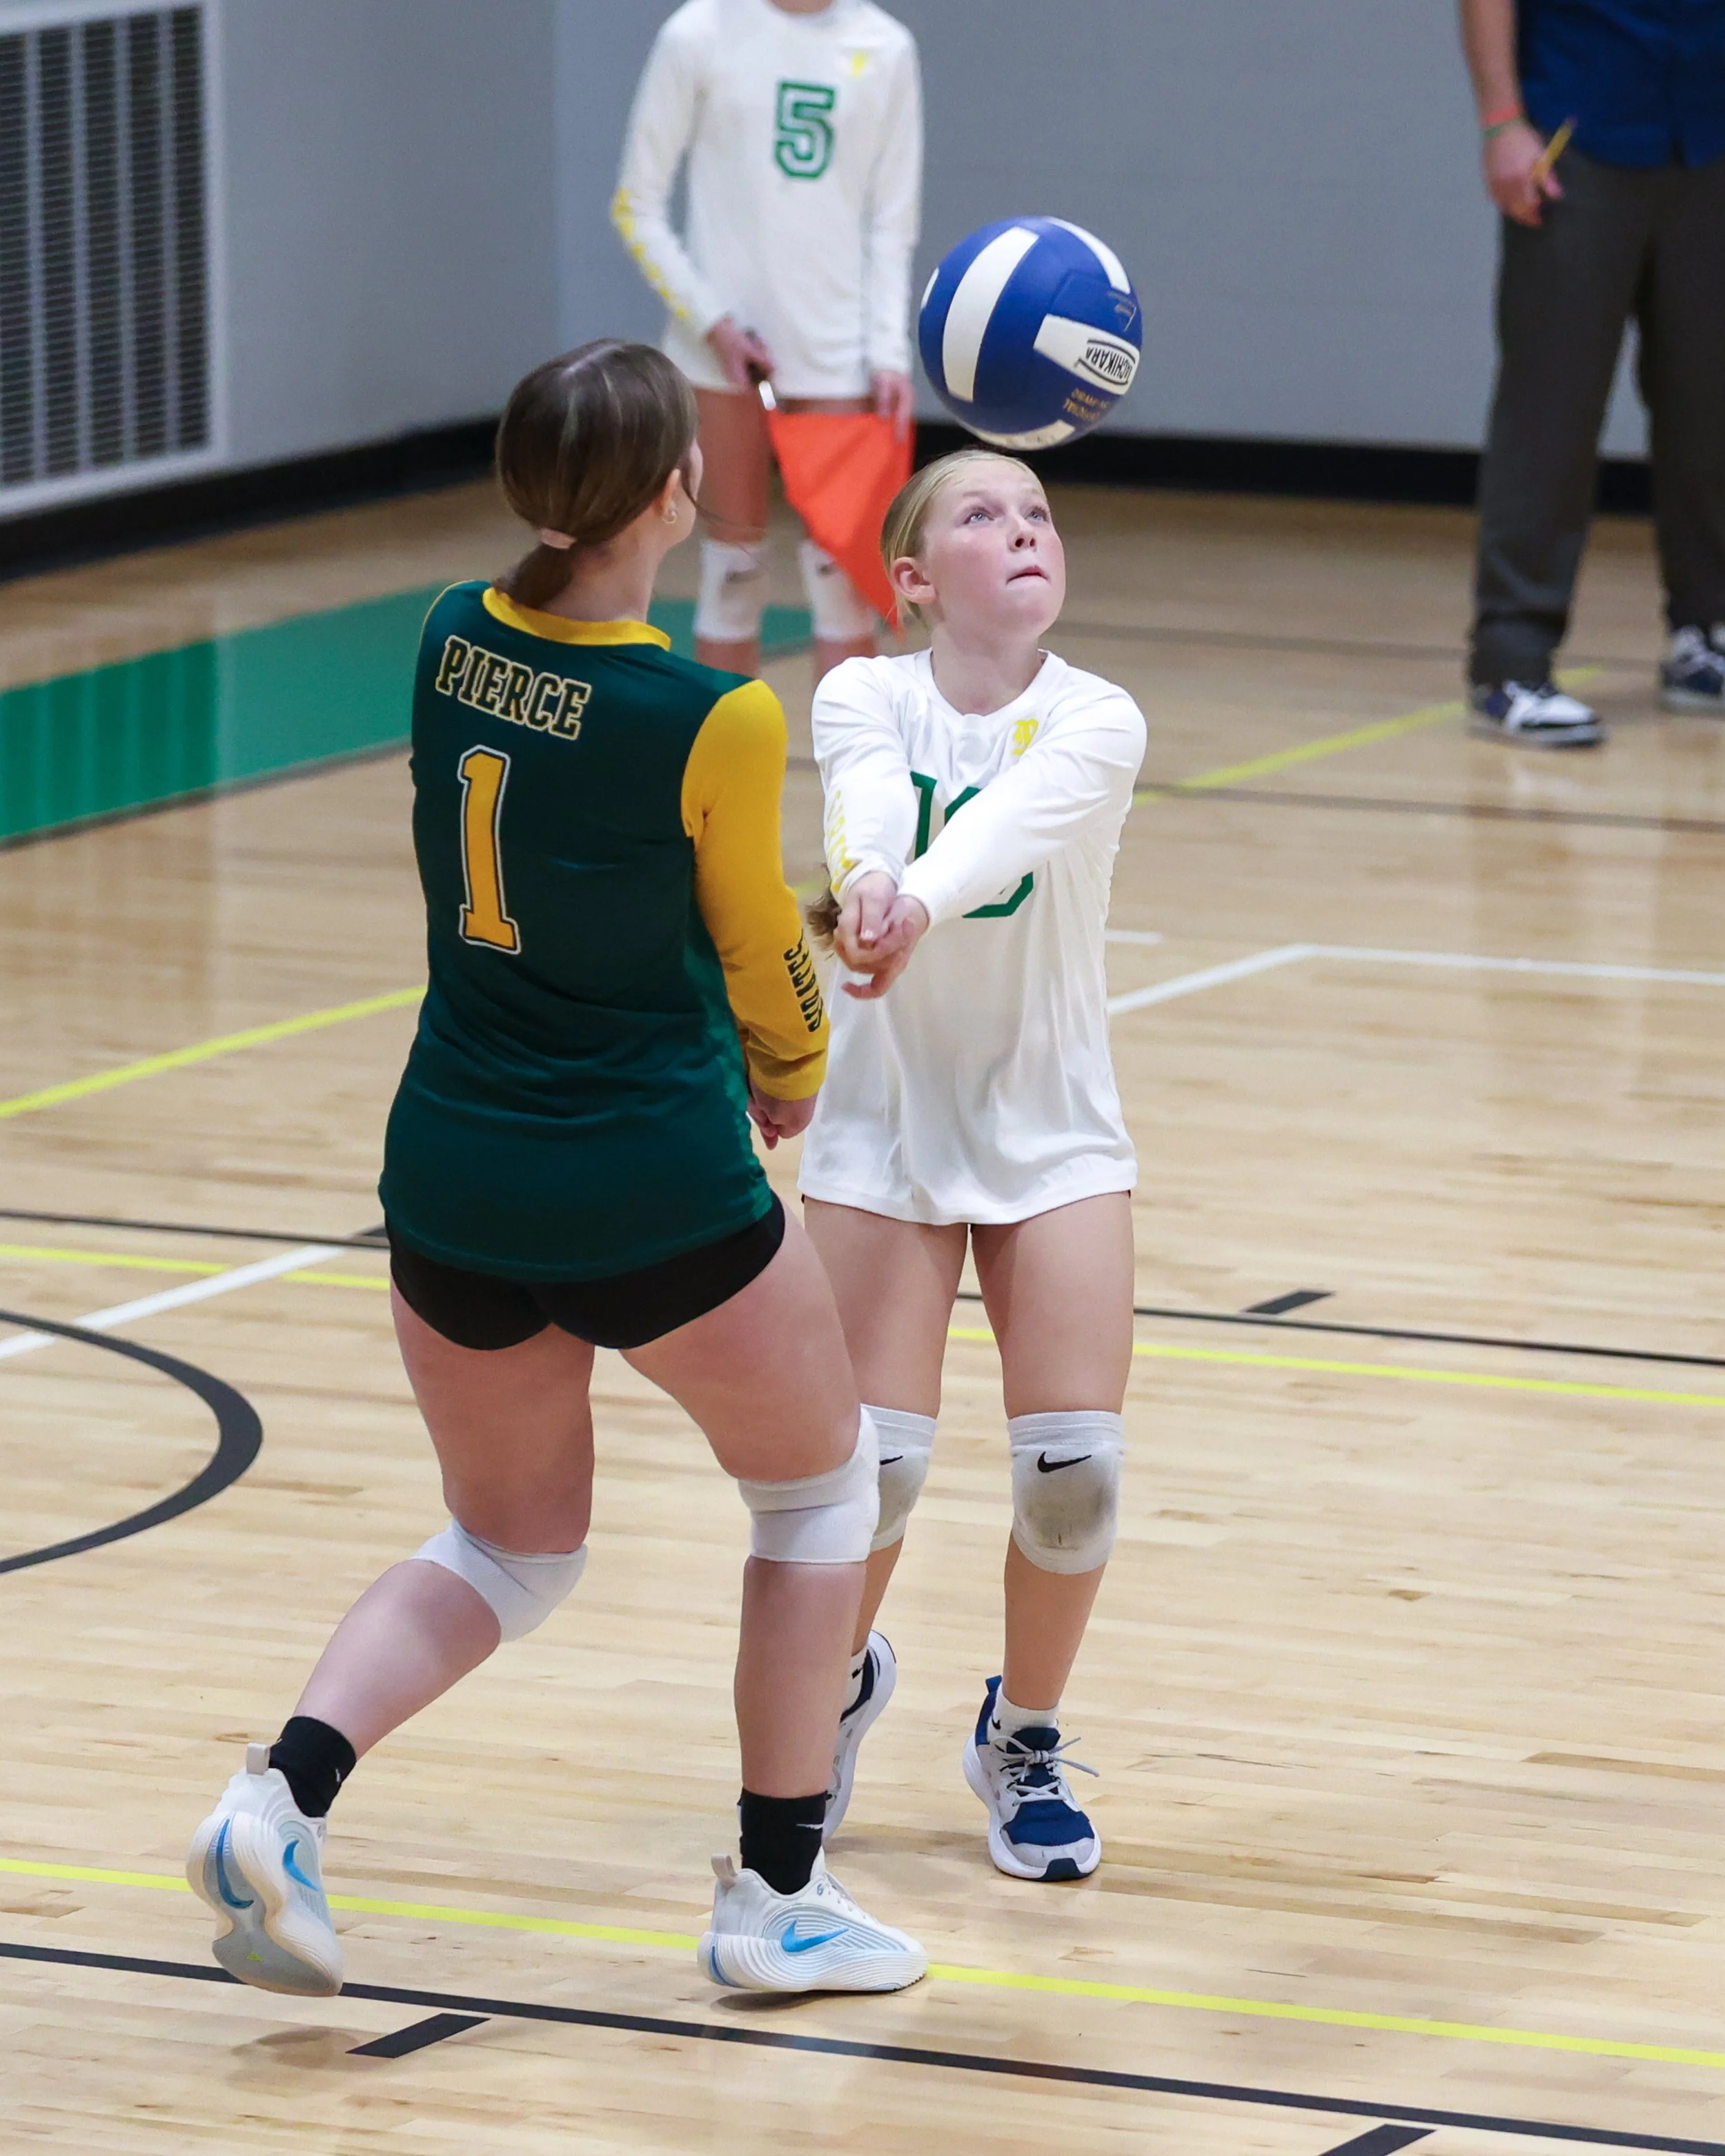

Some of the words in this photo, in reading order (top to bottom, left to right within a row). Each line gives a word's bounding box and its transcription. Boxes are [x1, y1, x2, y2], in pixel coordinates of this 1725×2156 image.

[774, 79, 835, 179] 5
[435, 634, 592, 740] PIERCE
[456, 744, 521, 955] 1
